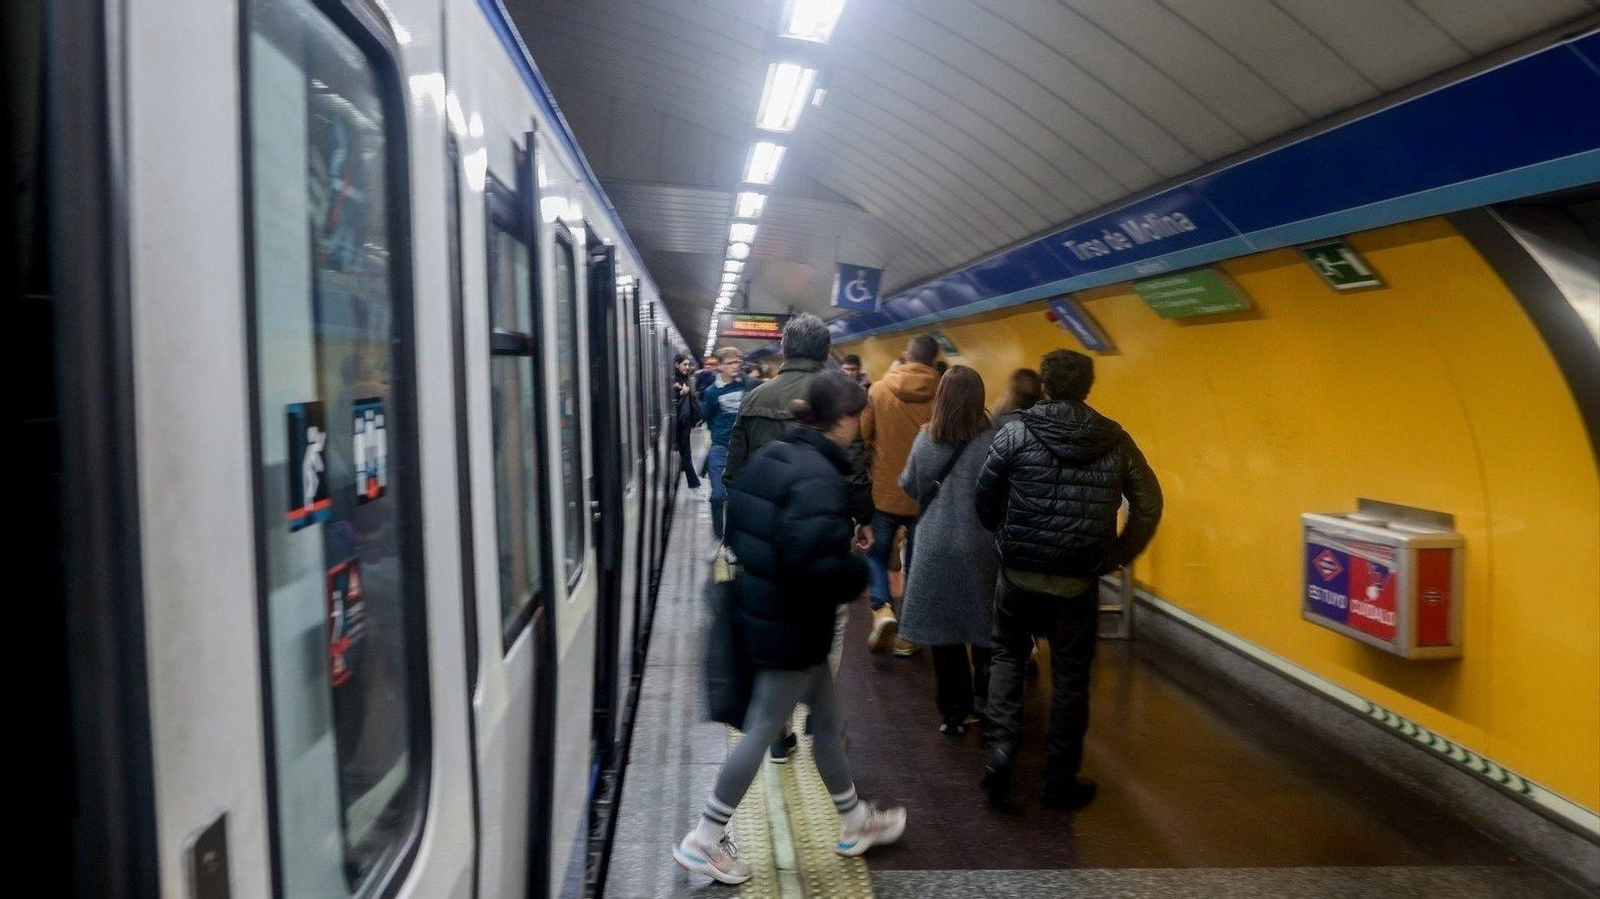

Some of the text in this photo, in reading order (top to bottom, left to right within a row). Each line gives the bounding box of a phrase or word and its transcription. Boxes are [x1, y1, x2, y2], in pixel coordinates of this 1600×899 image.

[1061, 212, 1197, 261] Tirso de Molina
